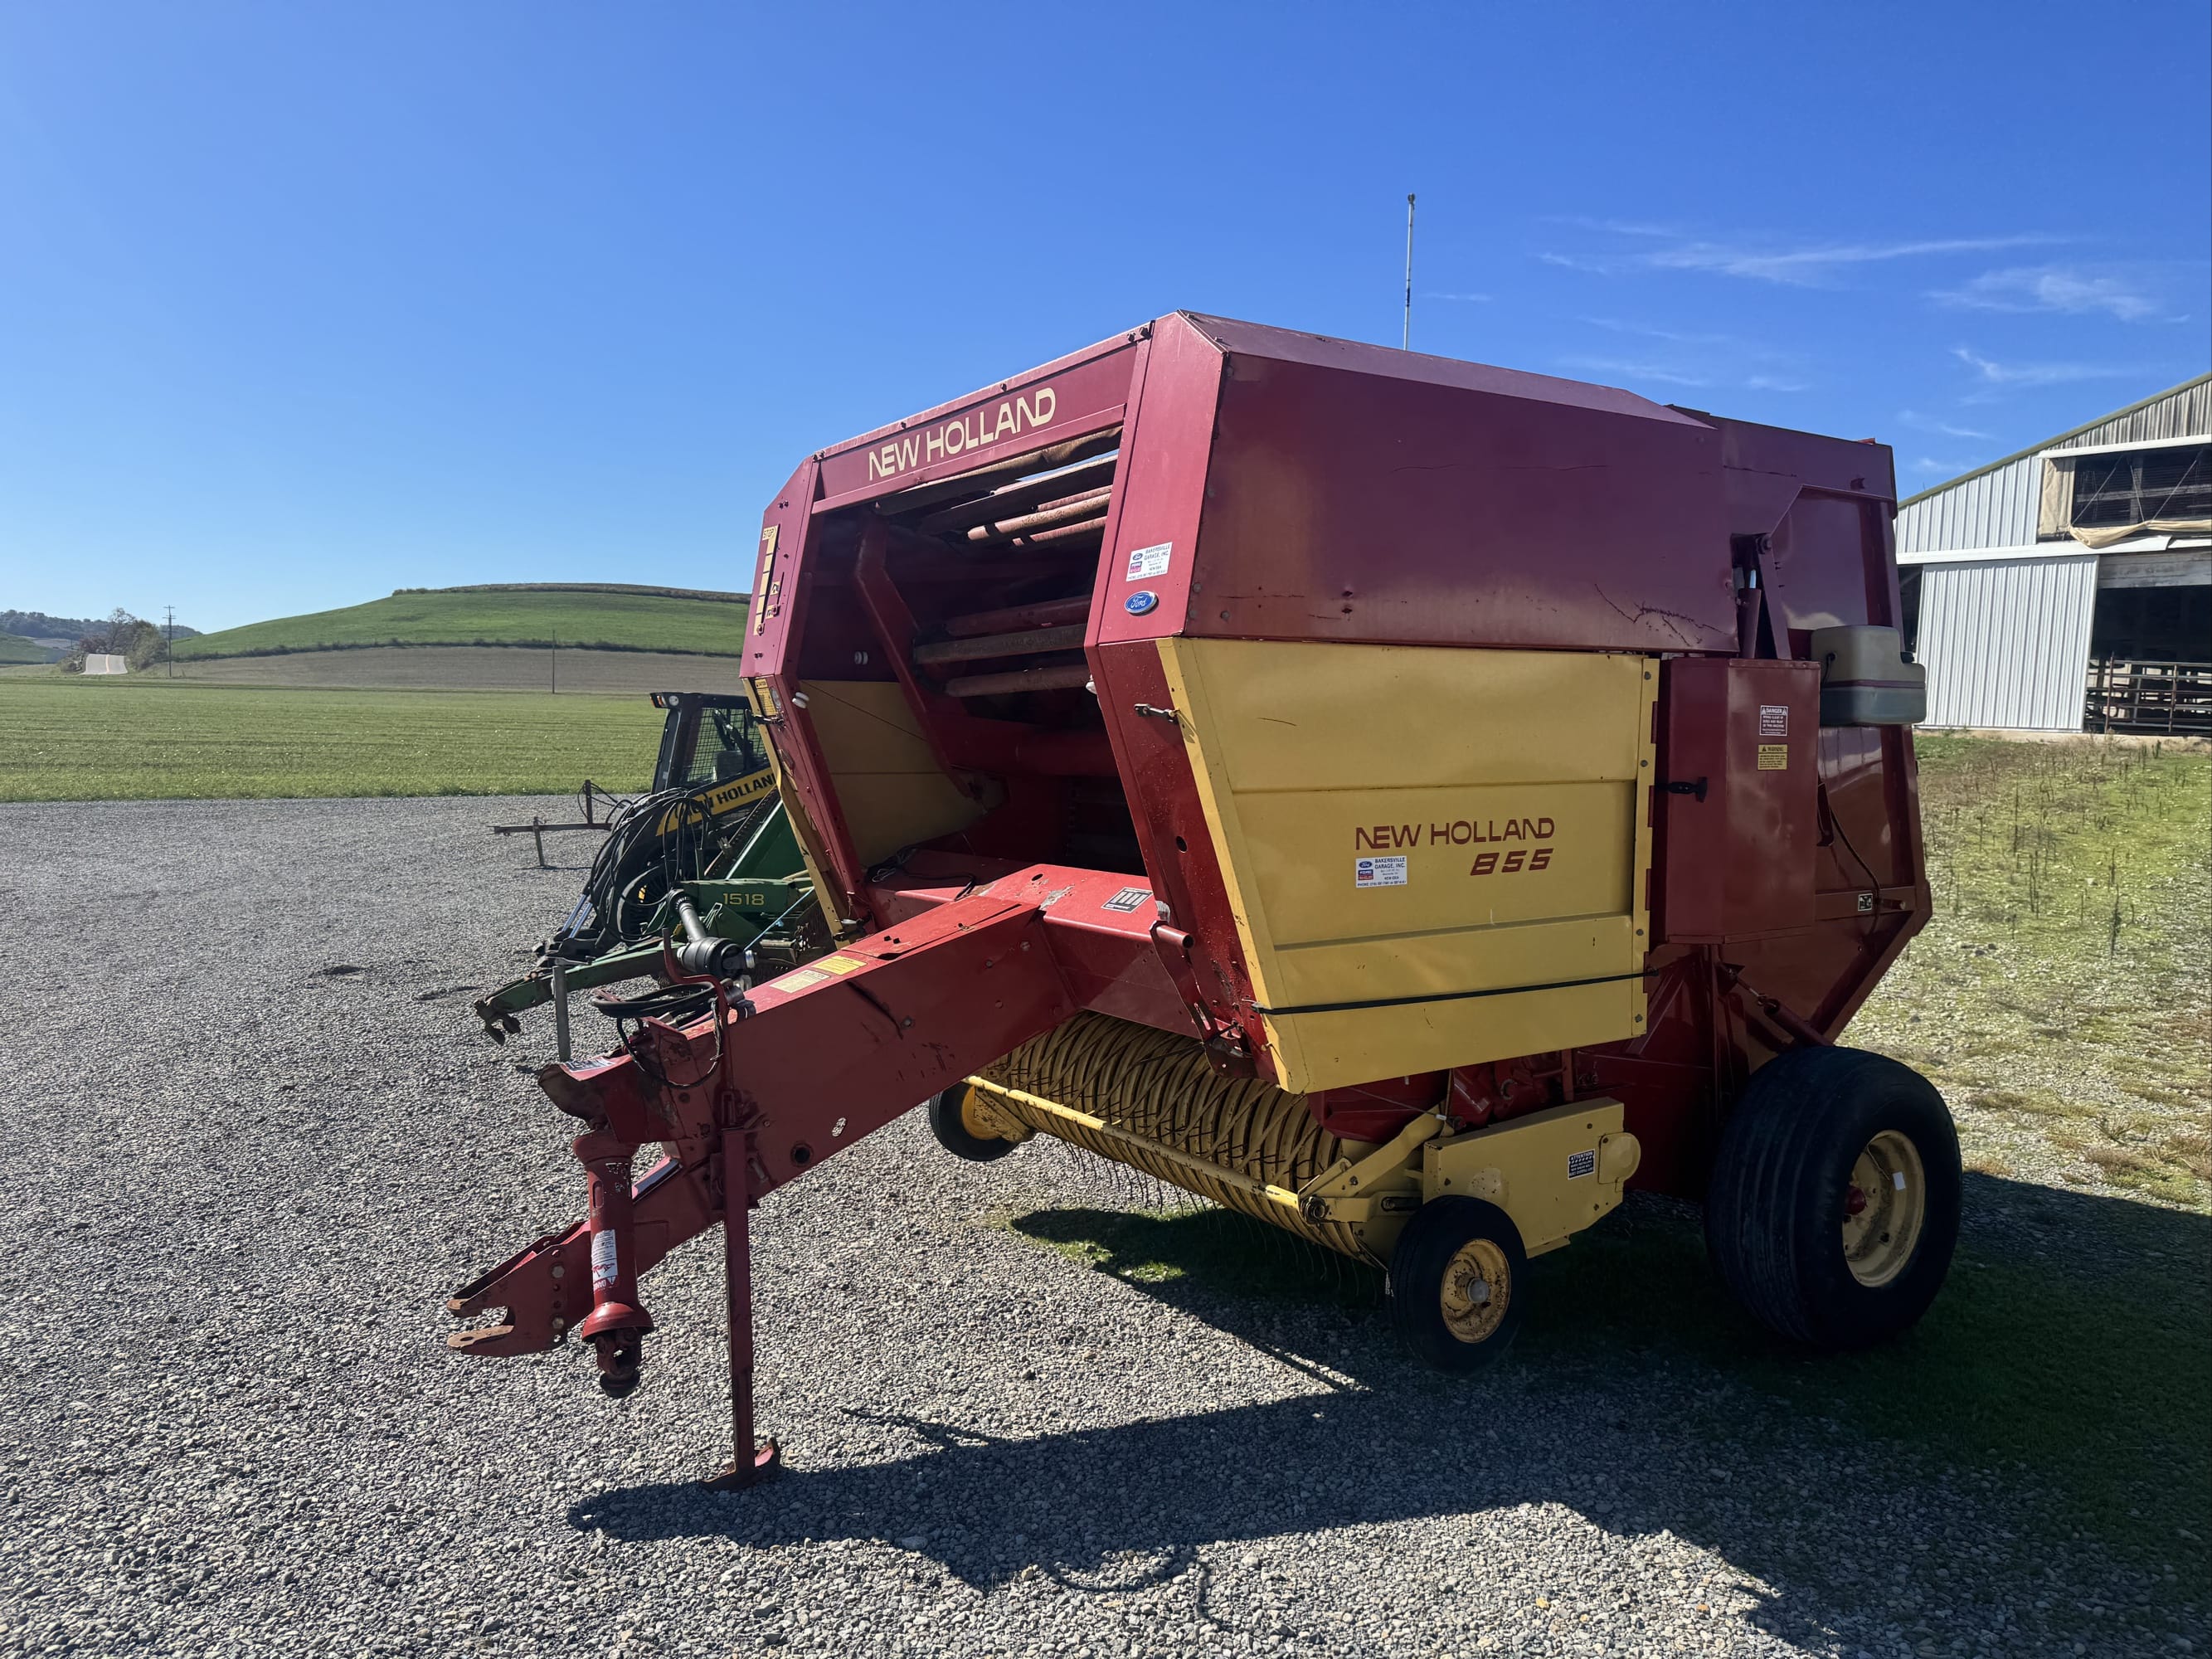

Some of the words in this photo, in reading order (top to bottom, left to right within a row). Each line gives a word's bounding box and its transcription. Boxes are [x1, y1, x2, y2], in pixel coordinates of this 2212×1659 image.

[868, 434, 920, 481] NEW
[926, 387, 1056, 463] HOLLAND
[717, 772, 776, 804] HOLLAN
[1355, 824, 1422, 850] NEW
[1431, 818, 1554, 844] HOLLAND
[1470, 848, 1554, 876] 855
[722, 893, 765, 906] 1518
